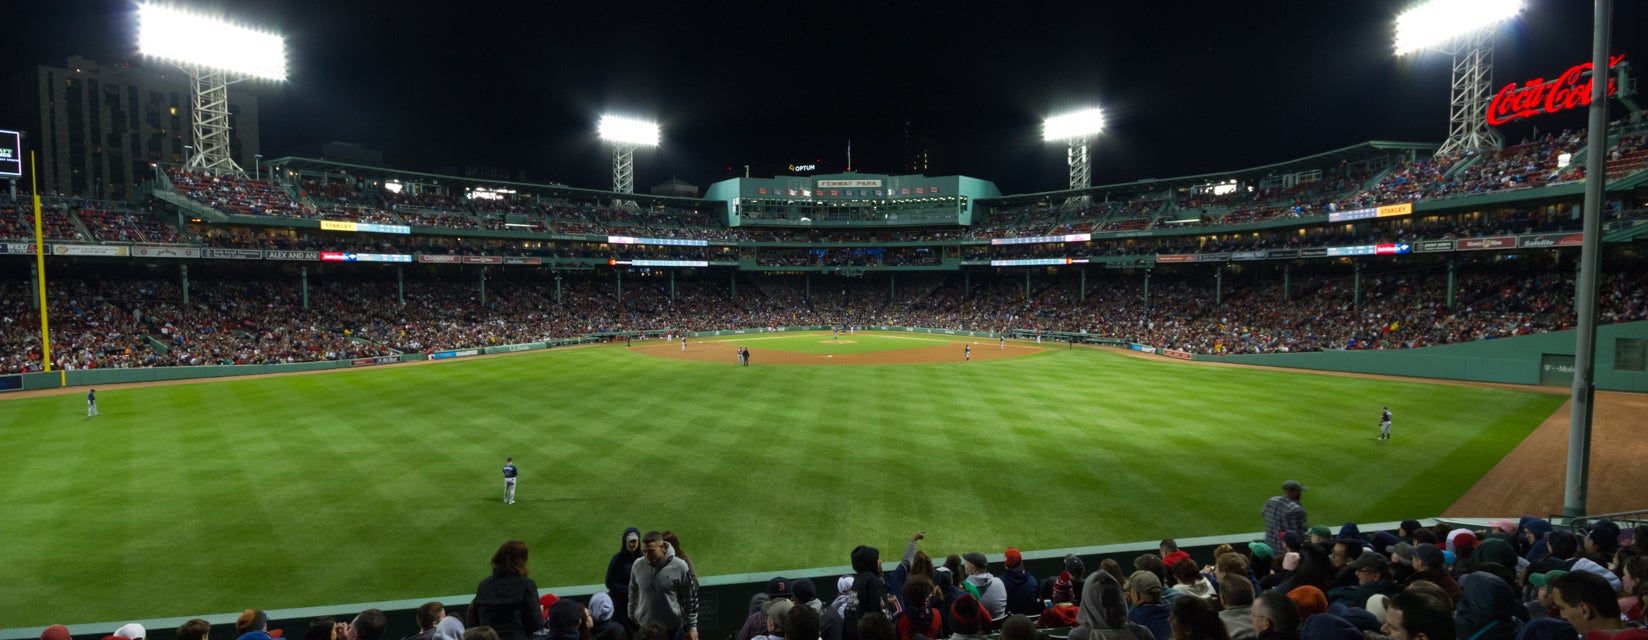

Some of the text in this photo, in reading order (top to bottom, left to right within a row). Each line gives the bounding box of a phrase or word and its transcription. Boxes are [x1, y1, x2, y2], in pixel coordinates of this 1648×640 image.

[795, 164, 815, 172] OPTUM
[1380, 206, 1406, 215] STANLEY
[325, 222, 352, 230] STANLEY
